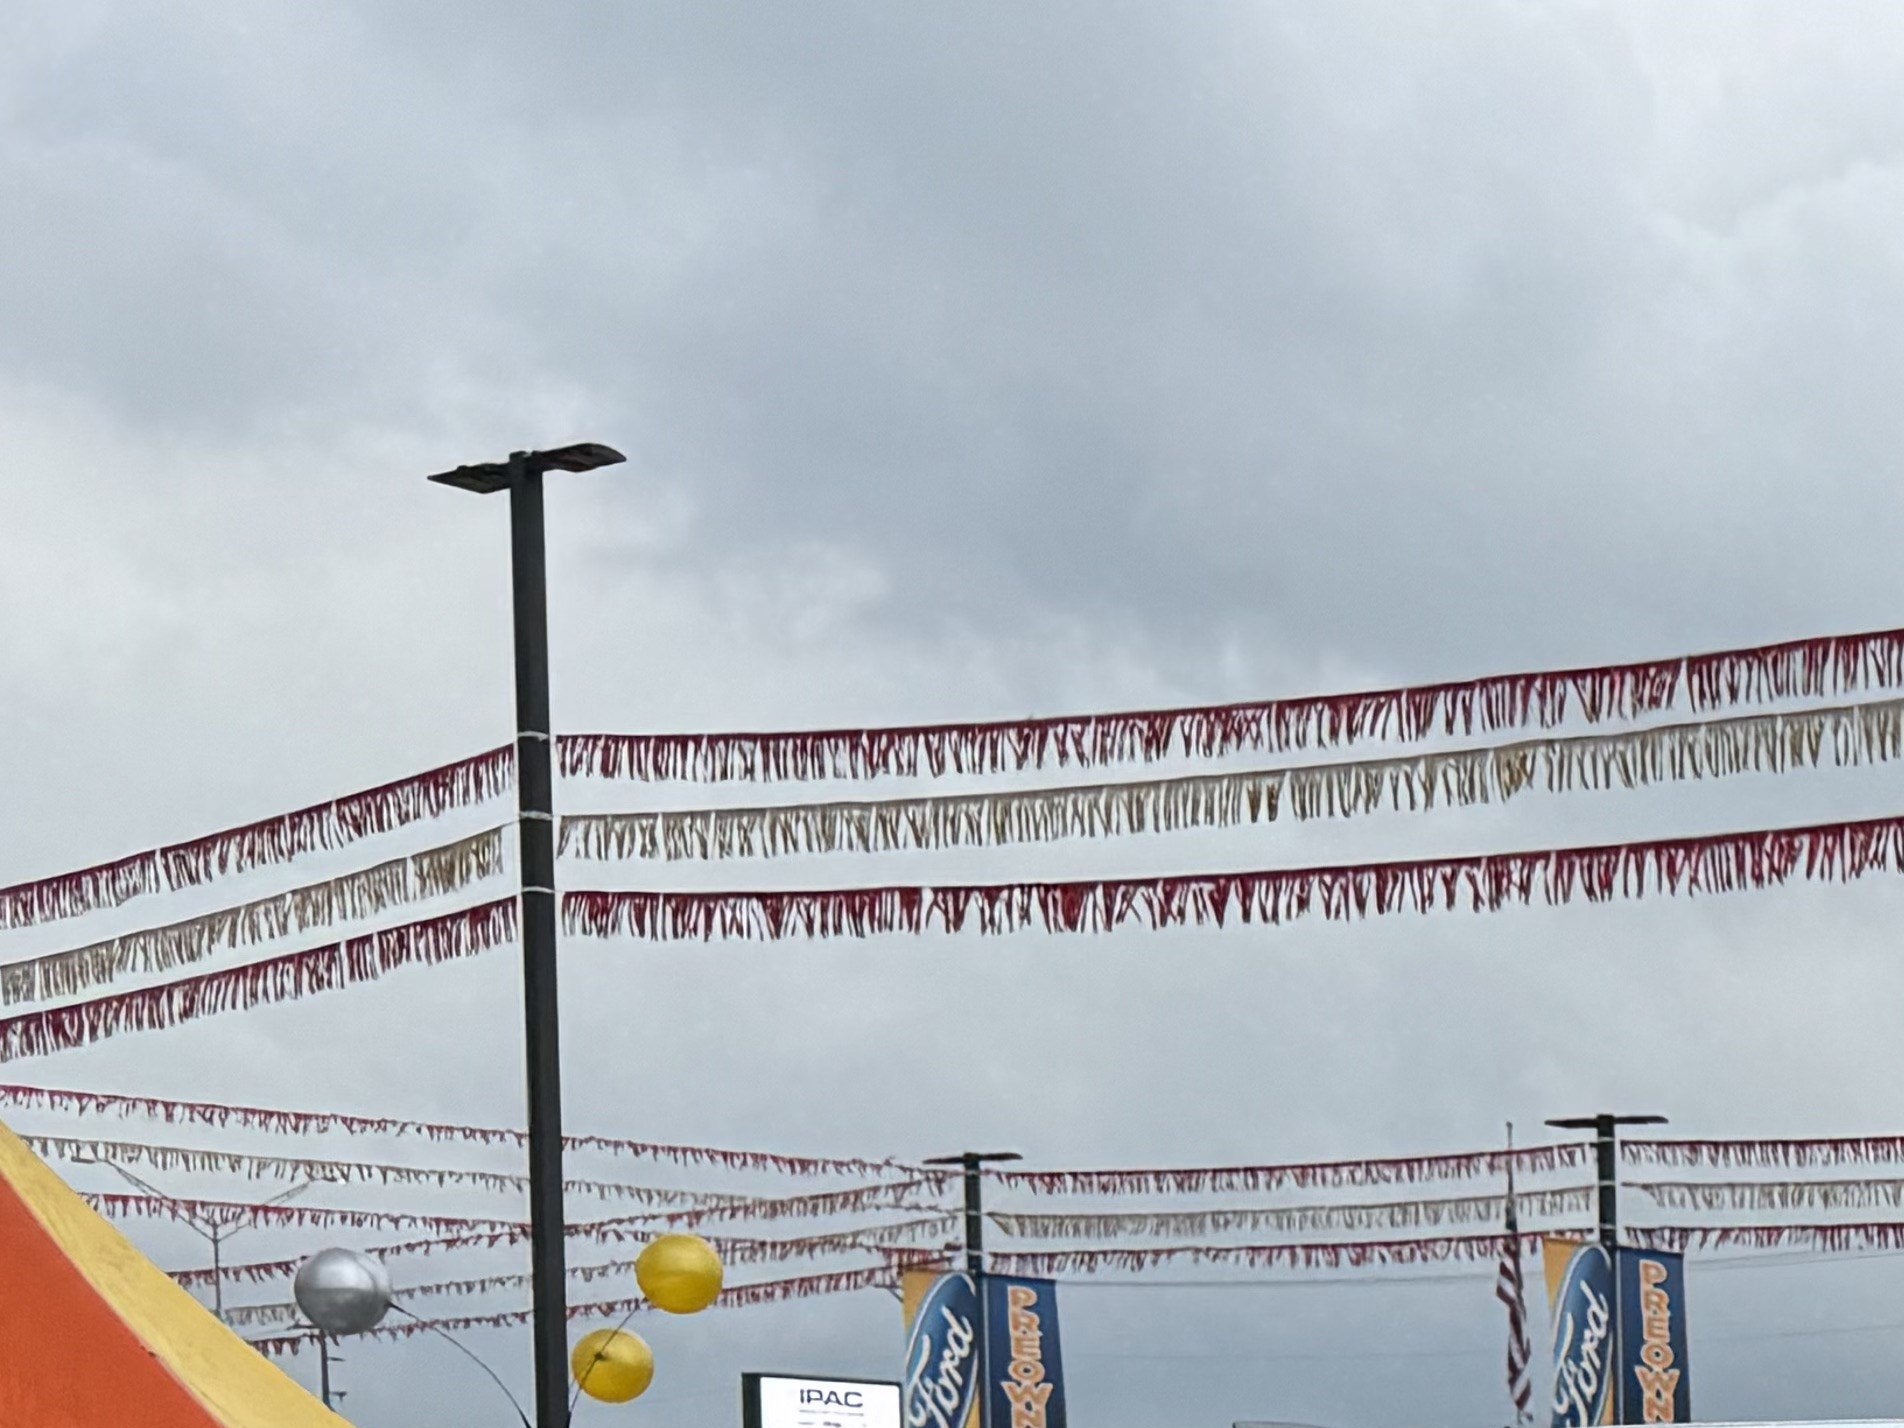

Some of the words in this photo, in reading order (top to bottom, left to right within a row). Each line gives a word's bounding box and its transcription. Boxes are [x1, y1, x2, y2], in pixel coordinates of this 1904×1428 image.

[799, 1388, 864, 1408] IPAC
[1552, 1280, 1609, 1428] Ford
[1634, 1259, 1680, 1423] PREOWN
